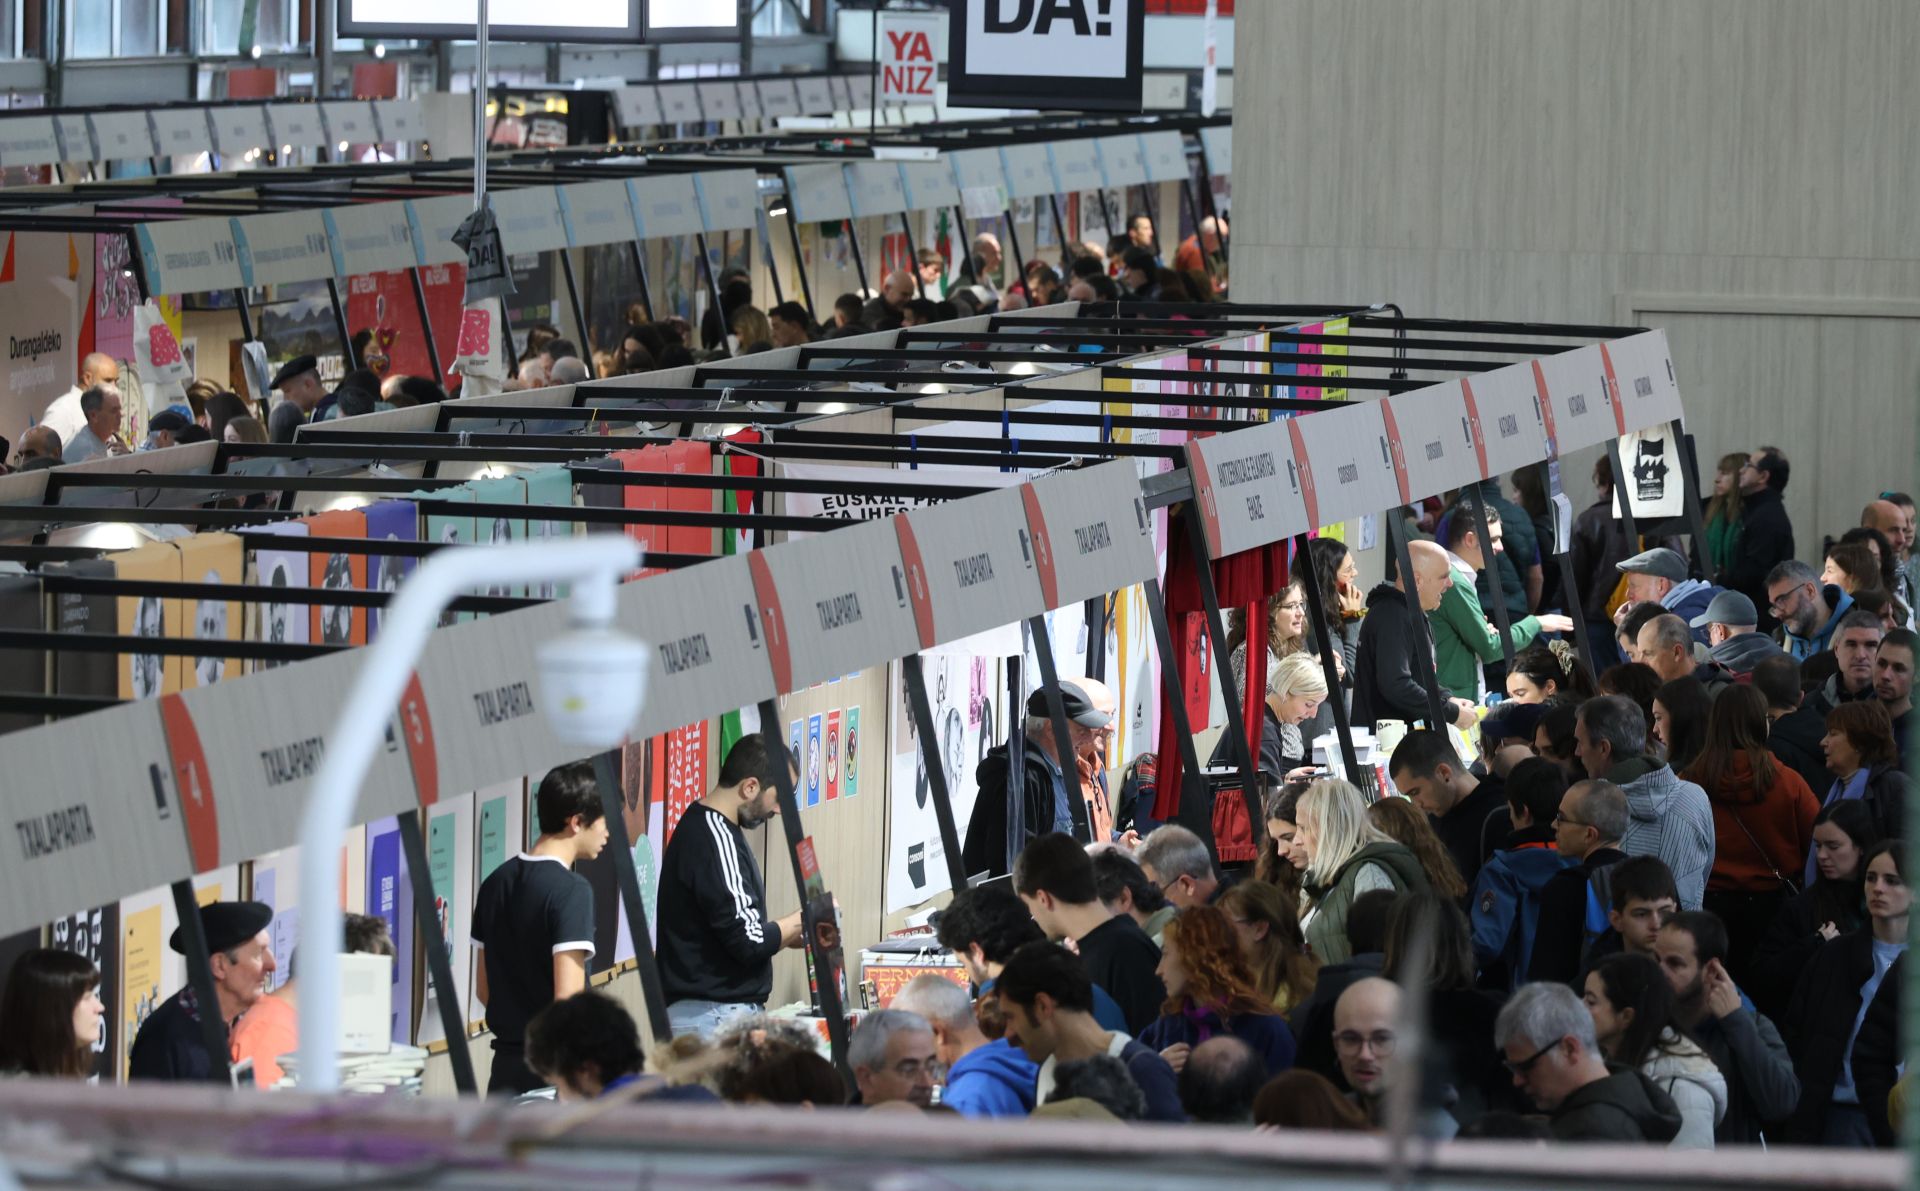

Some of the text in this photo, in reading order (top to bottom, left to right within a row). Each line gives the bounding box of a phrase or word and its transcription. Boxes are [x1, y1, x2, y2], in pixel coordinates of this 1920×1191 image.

[983, 0, 1112, 36] DA!
[887, 31, 933, 62] YA
[883, 65, 934, 95] NIZ
[10, 329, 61, 362] Durangaldeko
[822, 492, 905, 510] EUSKAL
[1038, 532, 1048, 561] 9
[1075, 521, 1111, 555] TXALAPARTA
[912, 564, 924, 600] 8
[954, 552, 995, 588] TXALAPARTA
[768, 608, 780, 645] 7
[816, 592, 862, 631] TXALAPARTA
[659, 633, 712, 676] TXALAPARTA
[408, 700, 424, 744] 5
[473, 680, 535, 728] TXALAPARTA
[188, 761, 204, 808] 4
[15, 802, 96, 862] TXALAPARTA
[909, 847, 924, 865] consonni
